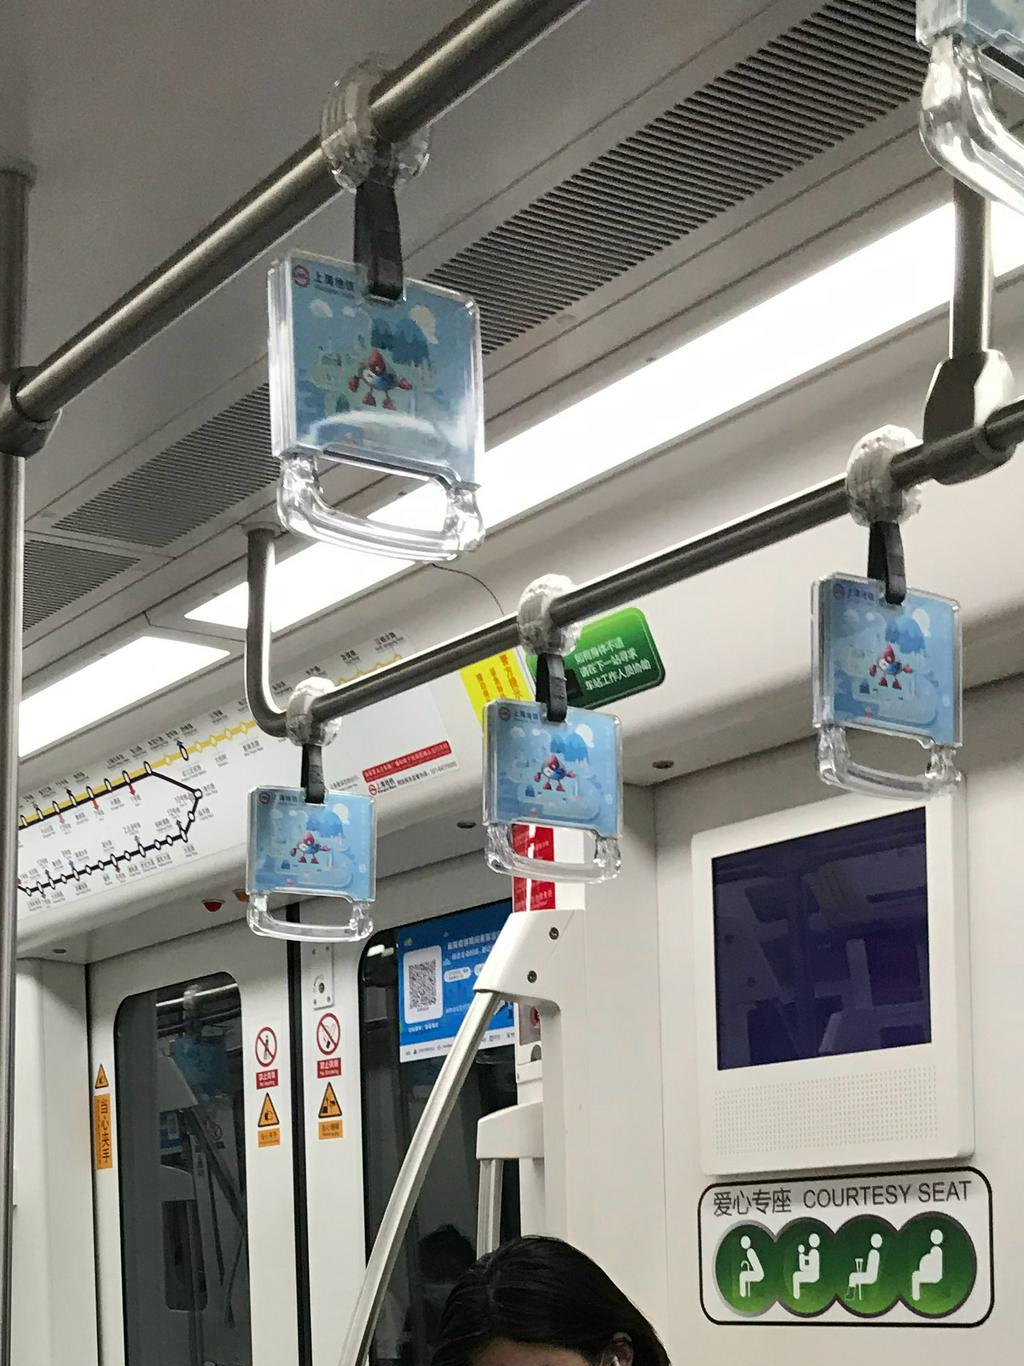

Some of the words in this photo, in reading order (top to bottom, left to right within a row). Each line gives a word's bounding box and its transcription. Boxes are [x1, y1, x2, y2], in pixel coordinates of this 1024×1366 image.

[579, 647, 638, 678] 请在下一站寻求
[585, 658, 652, 691] 车站工作人员协助
[713, 1187, 792, 1217] 爱心专座
[803, 1183, 913, 1209] COURTESY
[917, 1180, 972, 1203] SEAT
